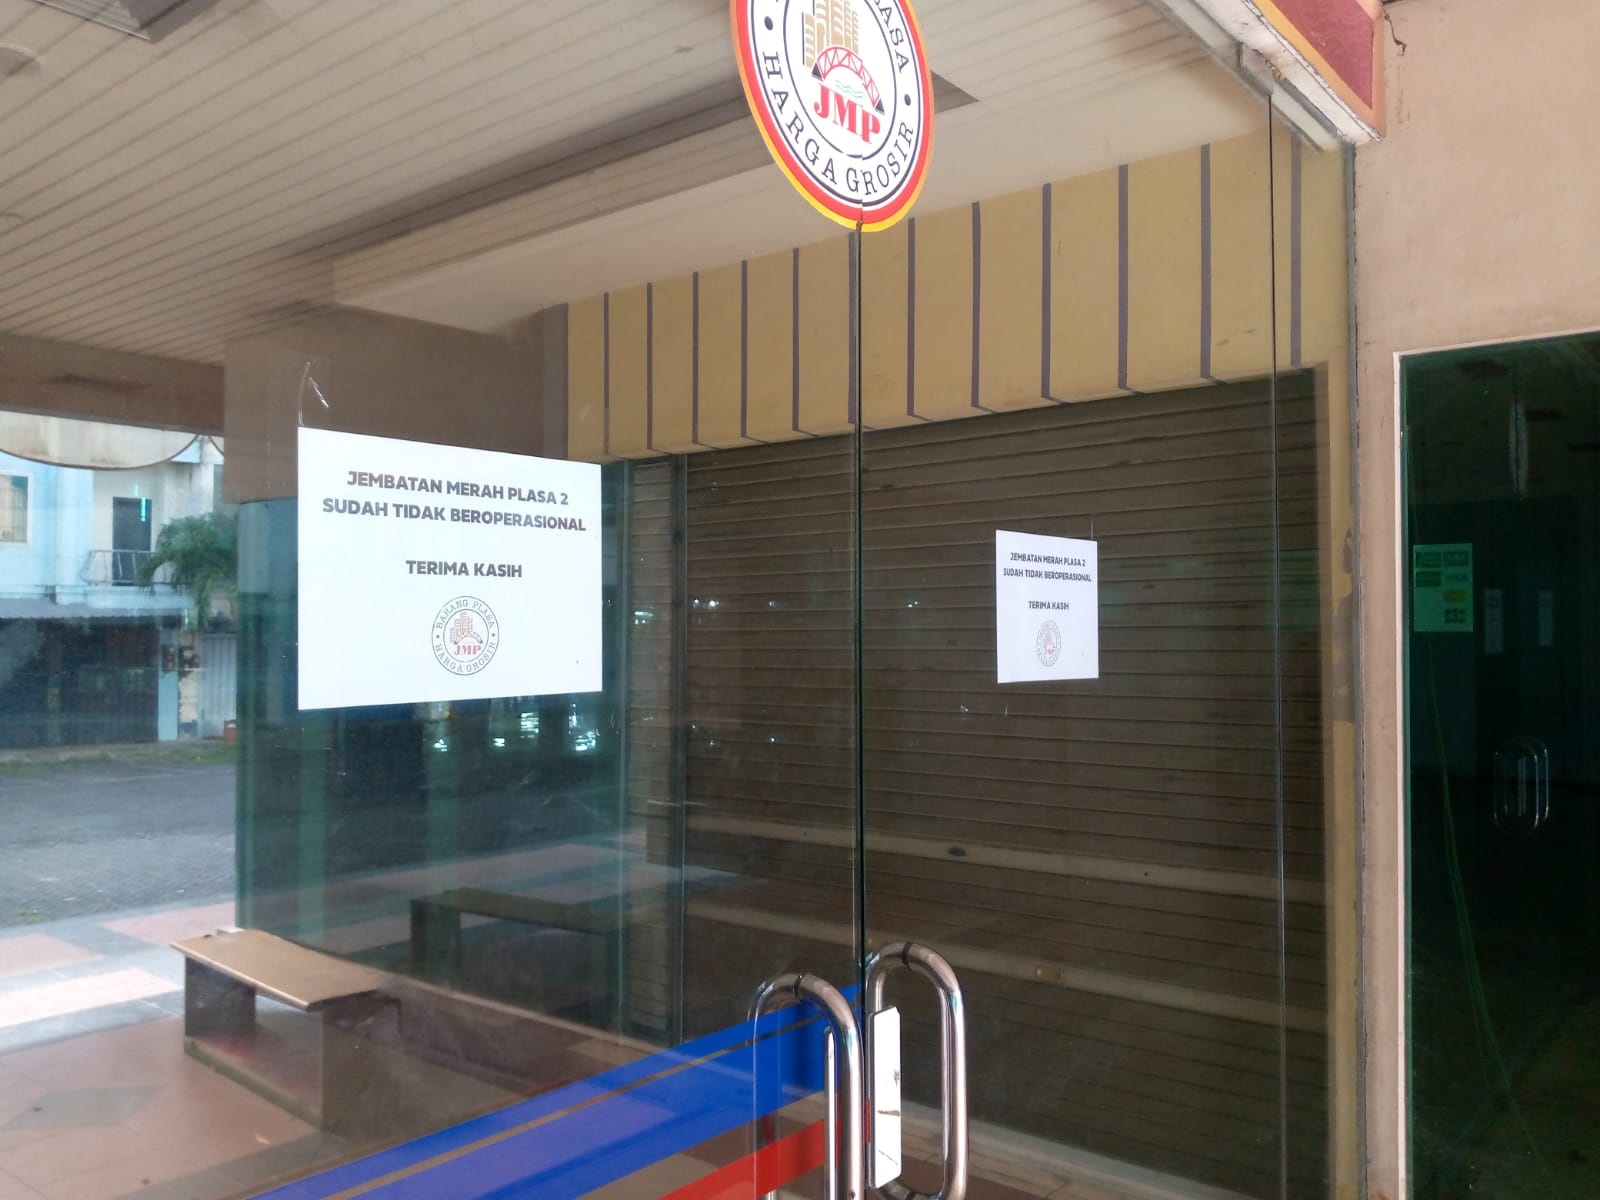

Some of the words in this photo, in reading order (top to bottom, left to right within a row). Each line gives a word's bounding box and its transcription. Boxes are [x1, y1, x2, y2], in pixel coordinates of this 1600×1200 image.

[875, 0, 909, 73] ASA
[762, 51, 838, 185] HARGA
[845, 121, 914, 196] GROSIR
[814, 83, 881, 144] JMP
[346, 470, 443, 494] JEMBATAN
[446, 480, 504, 500] MERAH
[507, 483, 557, 505] PLASA
[560, 492, 569, 505] 2
[322, 498, 388, 517] SUDAH
[392, 503, 446, 521] TIDAK
[450, 508, 587, 532] BEROPERASIONAL
[405, 560, 469, 576] TERIMA
[473, 563, 523, 578] KASIH
[1010, 552, 1042, 563] JEMBATAN
[1043, 555, 1063, 565] MERAH
[1063, 558, 1081, 567] PLASA
[1003, 567, 1023, 577] SUDAH
[1025, 569, 1043, 579] TIDAK
[1044, 570, 1092, 582] BEROPERASIONAL
[1029, 601, 1051, 610] TERIMA
[1052, 602, 1069, 610] KASIH
[435, 643, 463, 672] HARGA
[454, 645, 482, 655] JMP
